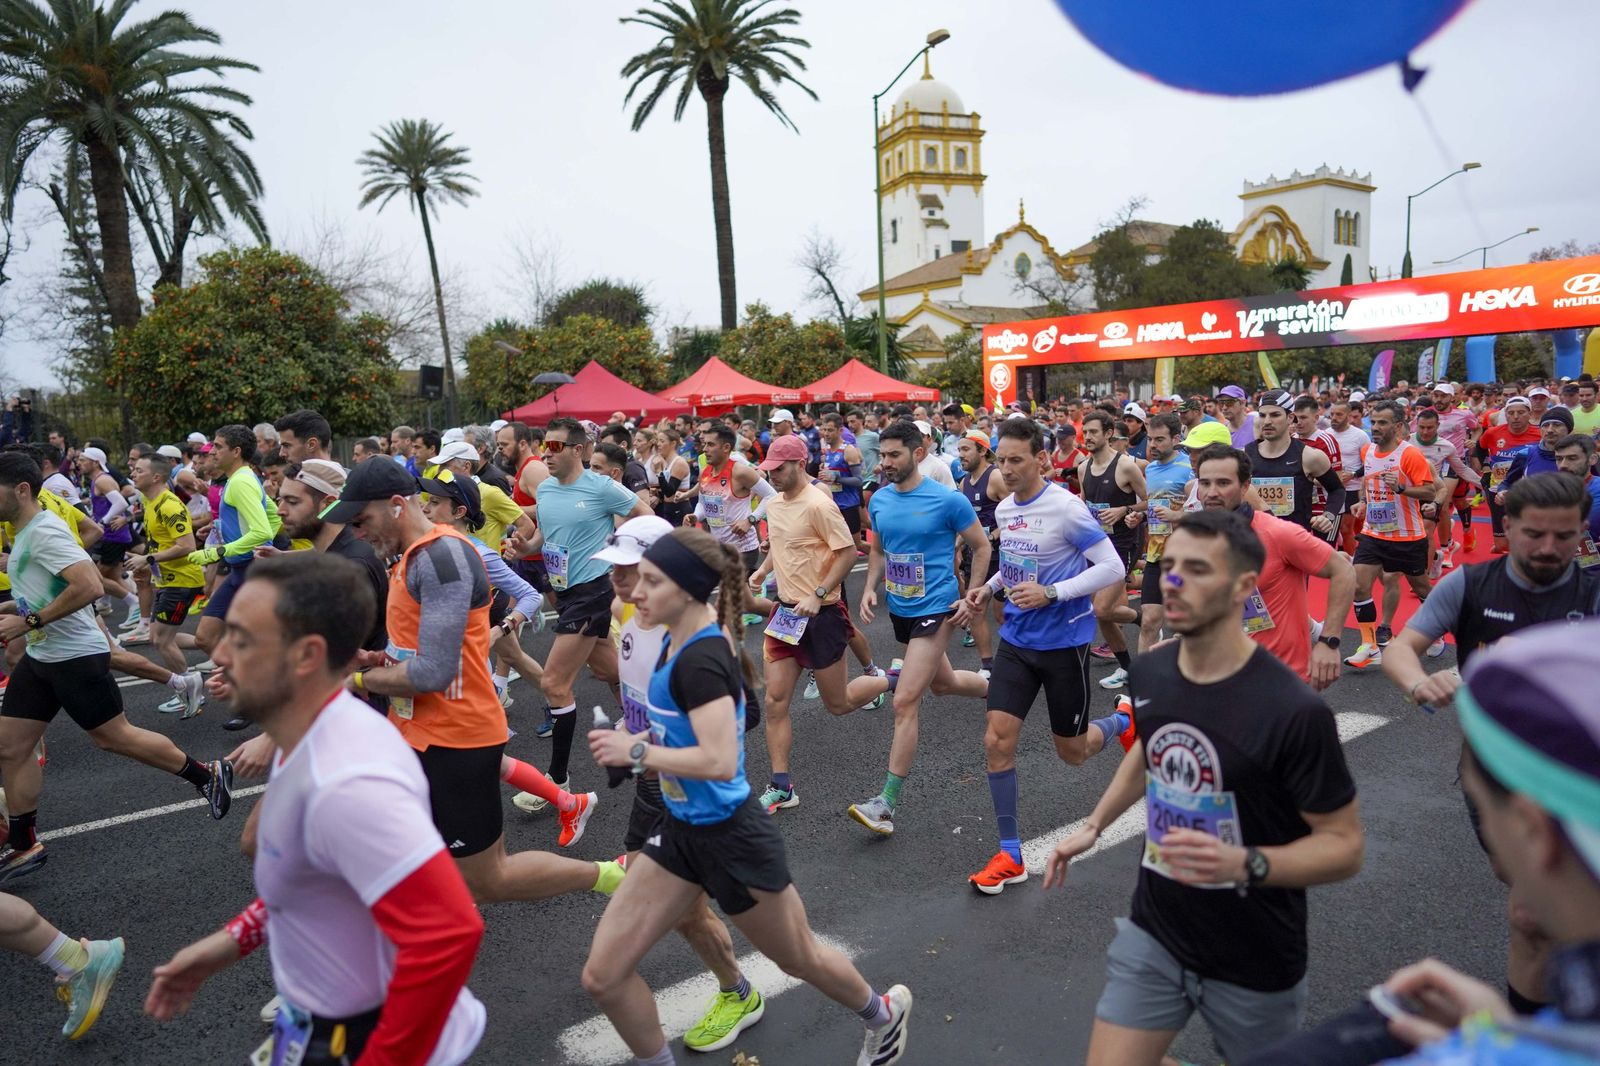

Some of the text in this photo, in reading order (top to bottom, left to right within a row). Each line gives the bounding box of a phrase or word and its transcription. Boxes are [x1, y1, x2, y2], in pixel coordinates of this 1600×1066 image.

[1459, 285, 1538, 313] HOKA
[1258, 299, 1344, 323] maratón
[1136, 321, 1187, 343] HOKA
[1277, 314, 1347, 336] sevilla
[1257, 487, 1284, 499] 4333
[1002, 563, 1024, 583] 2081
